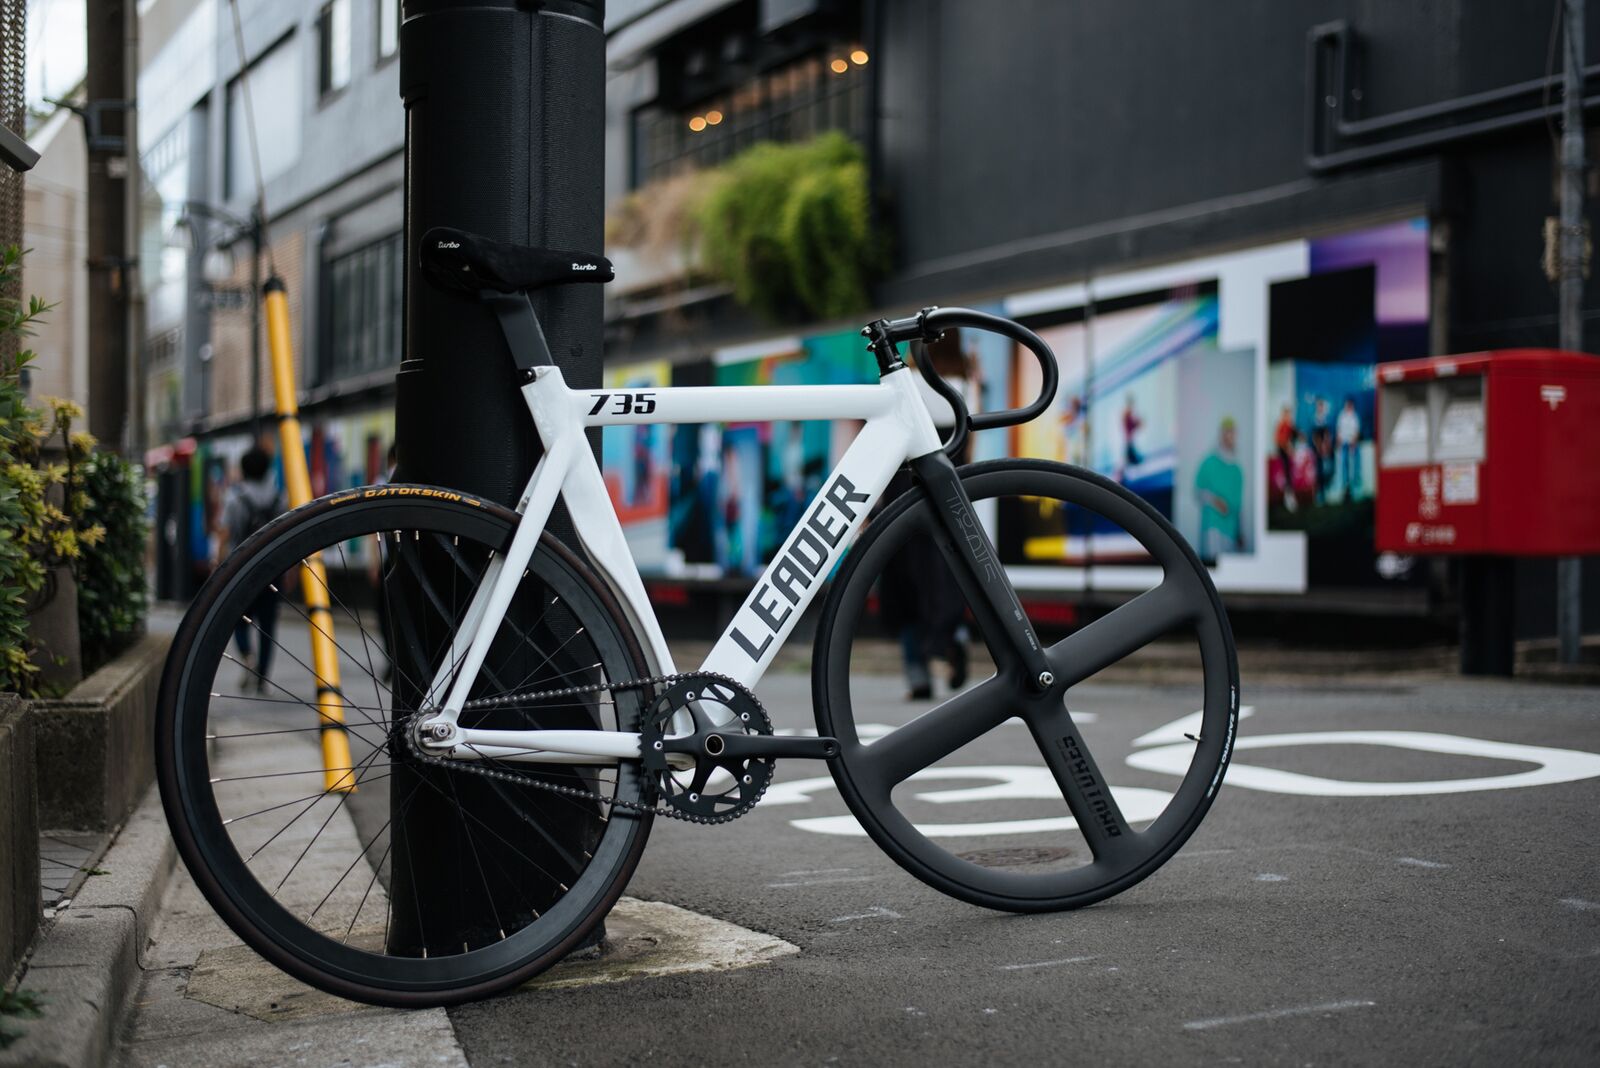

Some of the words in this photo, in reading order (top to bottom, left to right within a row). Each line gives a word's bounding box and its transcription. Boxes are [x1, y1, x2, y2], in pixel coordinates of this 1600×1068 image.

[438, 240, 461, 249] turbo
[571, 262, 598, 271] turbo
[588, 392, 656, 416] 735
[364, 487, 462, 501] GATORSKIN
[729, 473, 871, 663] LEADER
